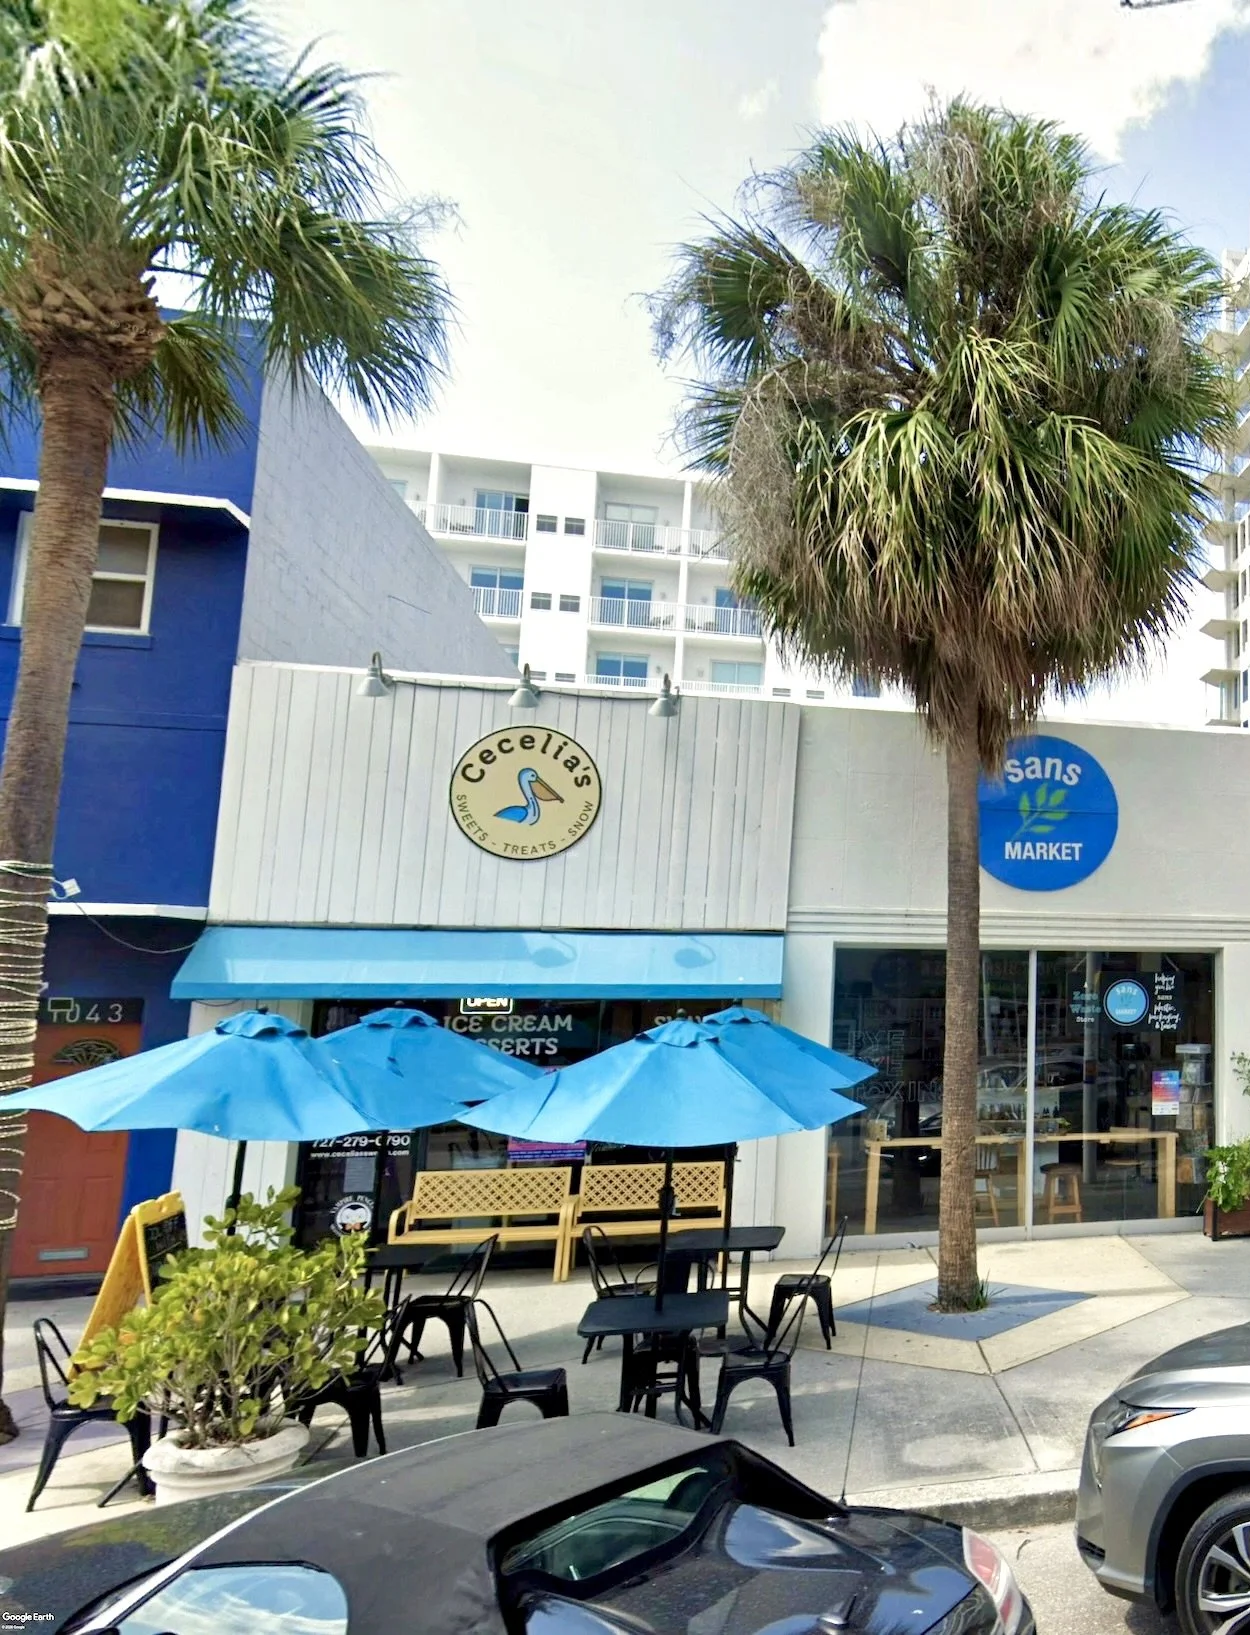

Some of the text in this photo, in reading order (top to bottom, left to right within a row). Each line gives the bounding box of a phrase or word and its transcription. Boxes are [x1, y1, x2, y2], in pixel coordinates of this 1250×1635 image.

[461, 733, 591, 788] Cecelia's
[1004, 756, 1082, 786] sans
[456, 794, 594, 855] SWEETS TREATS SNOW
[1004, 841, 1083, 861] MARKET
[443, 1014, 573, 1033] ICE CREAM
[475, 1037, 559, 1056] SERTS
